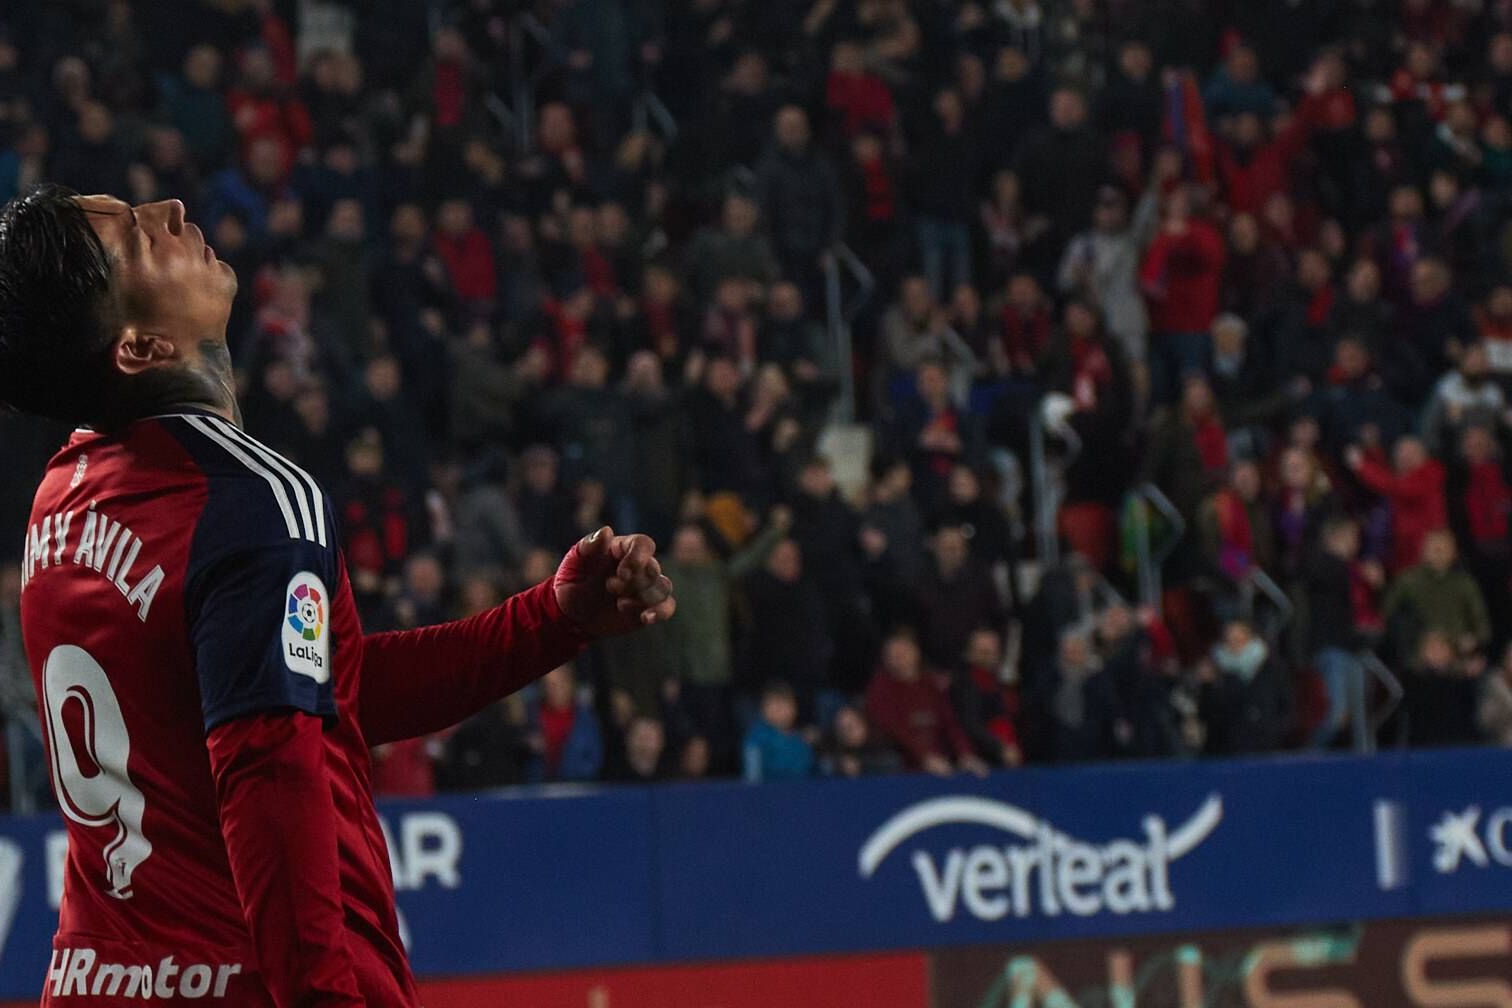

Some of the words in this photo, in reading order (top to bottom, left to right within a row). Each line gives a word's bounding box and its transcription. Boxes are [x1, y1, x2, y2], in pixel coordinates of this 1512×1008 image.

[73, 500, 165, 622] ÁVILA
[42, 643, 152, 900] 9
[50, 948, 242, 1000] HRmotor
